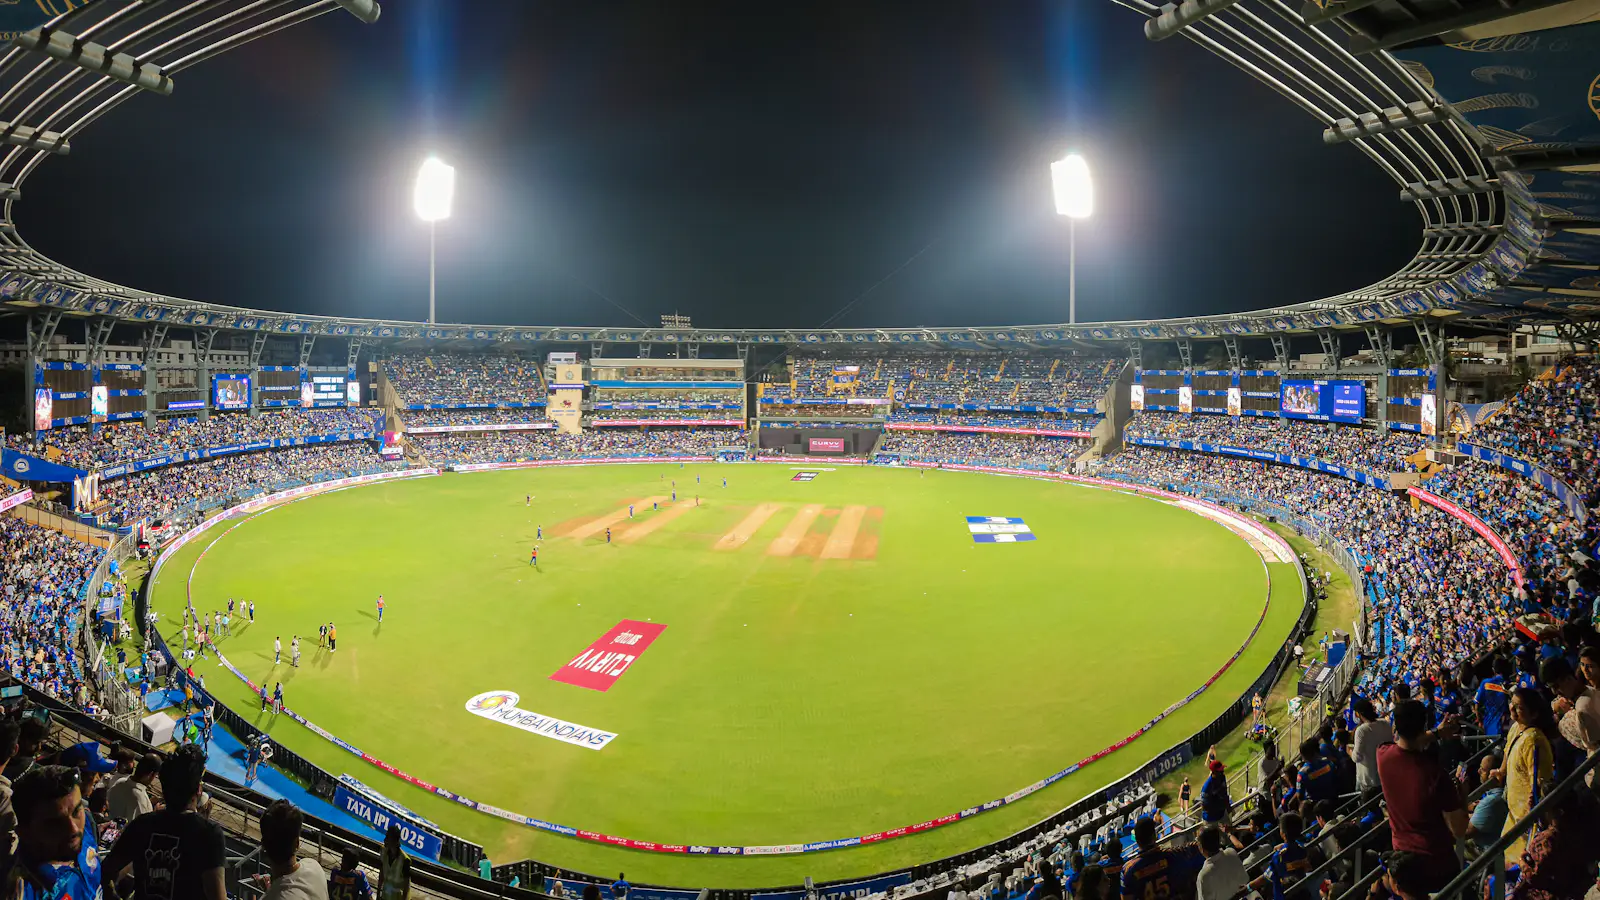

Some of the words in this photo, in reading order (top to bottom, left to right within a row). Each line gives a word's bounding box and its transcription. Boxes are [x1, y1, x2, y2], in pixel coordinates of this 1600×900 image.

[567, 648, 636, 677] CURVV
[492, 707, 548, 731] MUMBAI
[544, 720, 612, 745] INDIANS
[1159, 752, 1183, 775] 2025
[346, 796, 372, 822] TATA
[373, 811, 391, 831] IPL
[913, 821, 933, 829] CURVV
[580, 830, 600, 838] CURVV
[887, 827, 906, 835] CURVV
[607, 835, 628, 843] CURVV
[690, 846, 708, 854] RuPay
[718, 847, 736, 855] RuPay
